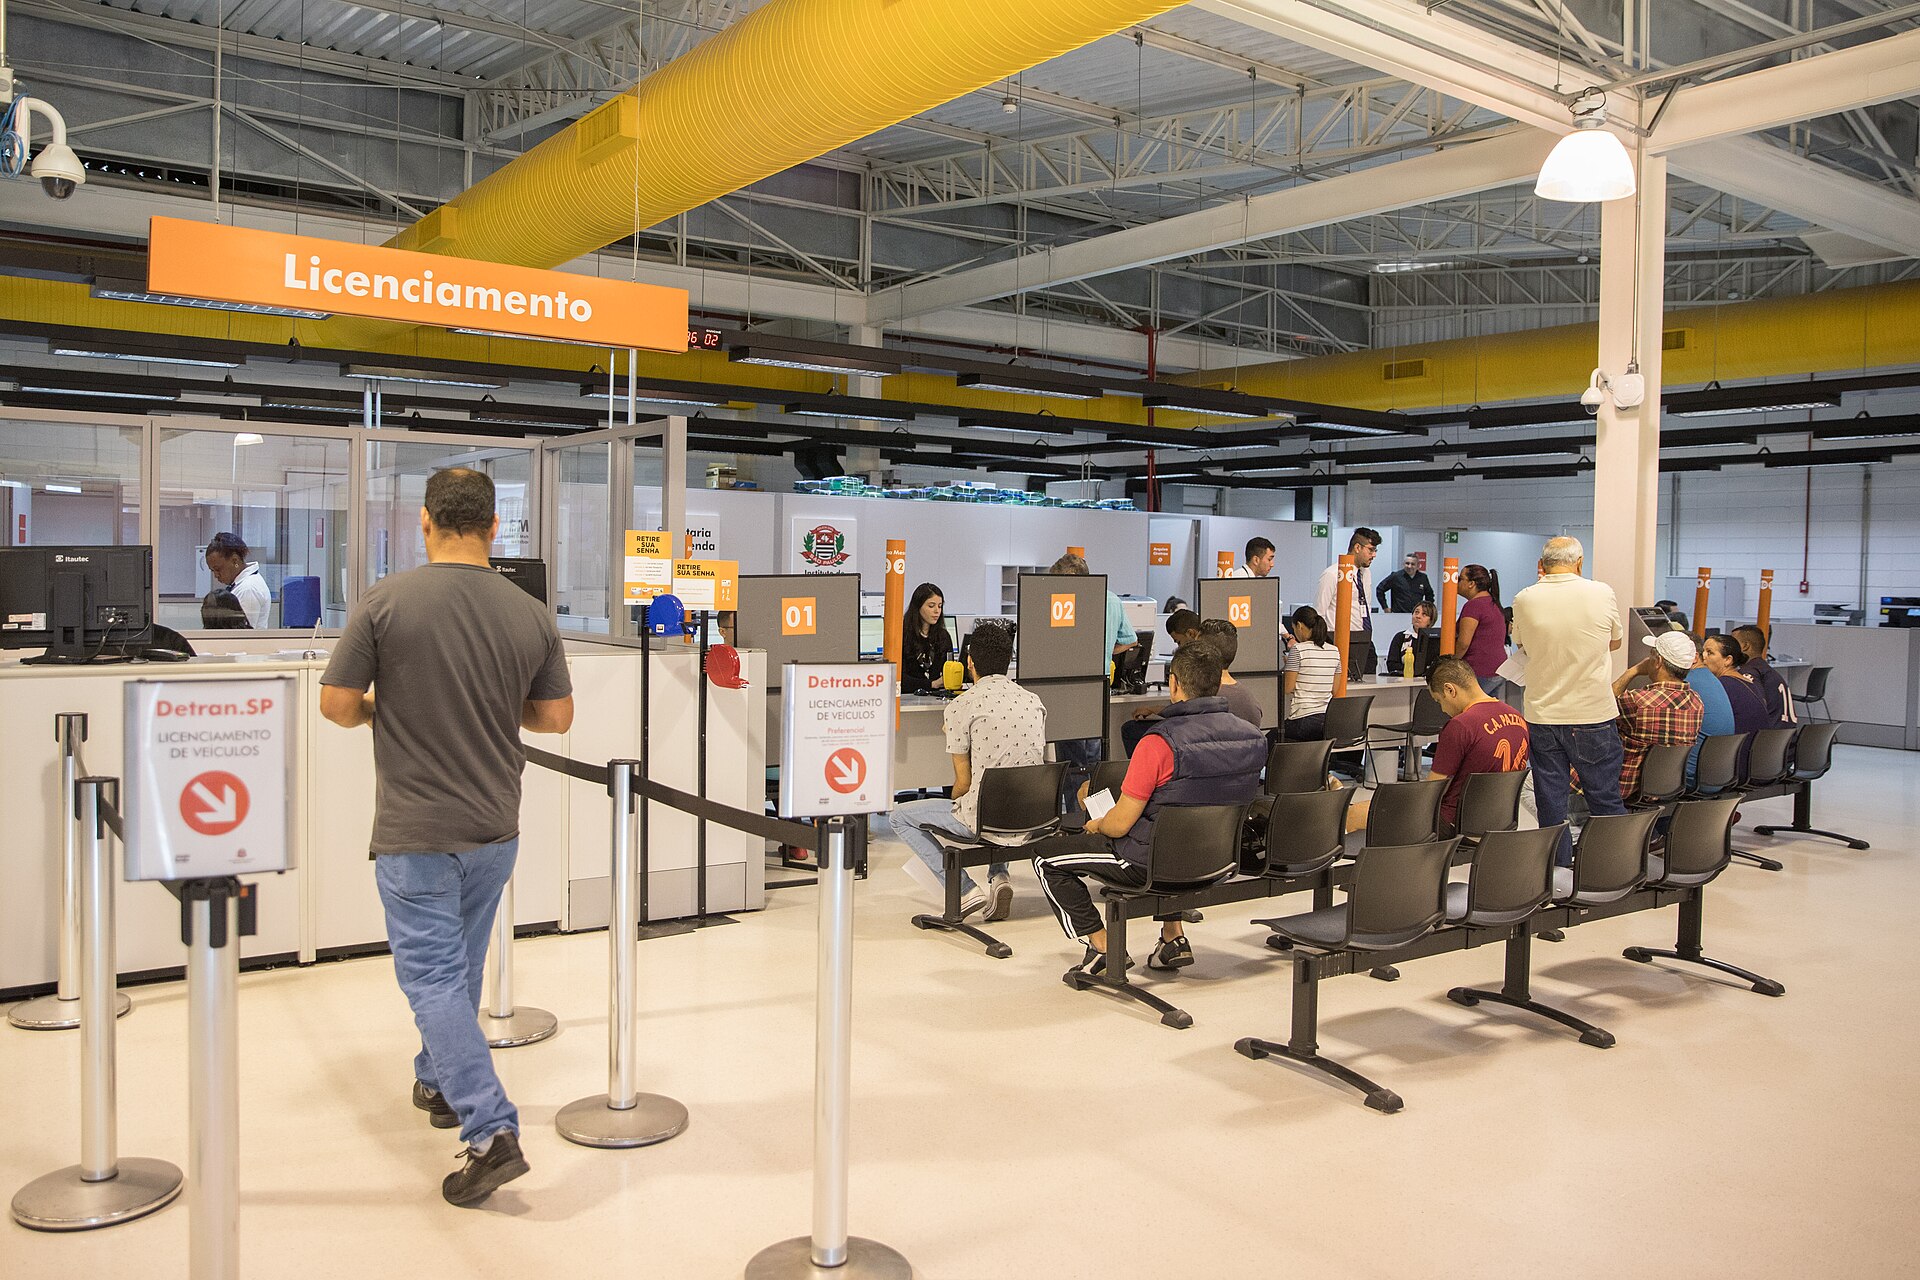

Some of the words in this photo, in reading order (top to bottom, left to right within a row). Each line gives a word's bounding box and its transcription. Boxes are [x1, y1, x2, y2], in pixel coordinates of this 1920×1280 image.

[284, 253, 593, 323] Licenciamento
[704, 333, 719, 346] 02
[636, 535, 661, 543] RETIRE
[786, 605, 813, 628] 01
[1052, 601, 1074, 620] 02
[1229, 602, 1250, 621] 03
[808, 674, 884, 689] Detran.SP
[156, 698, 273, 717] Detran.SP
[809, 698, 883, 709] LICENCIAMENTO
[817, 711, 829, 721] DE
[831, 709, 875, 720] VEÍCULOS
[158, 729, 271, 743] LICENCIAMENTO
[827, 726, 865, 735] Preferencial
[170, 747, 189, 759] DE
[193, 743, 260, 758] VEÍCULOS
